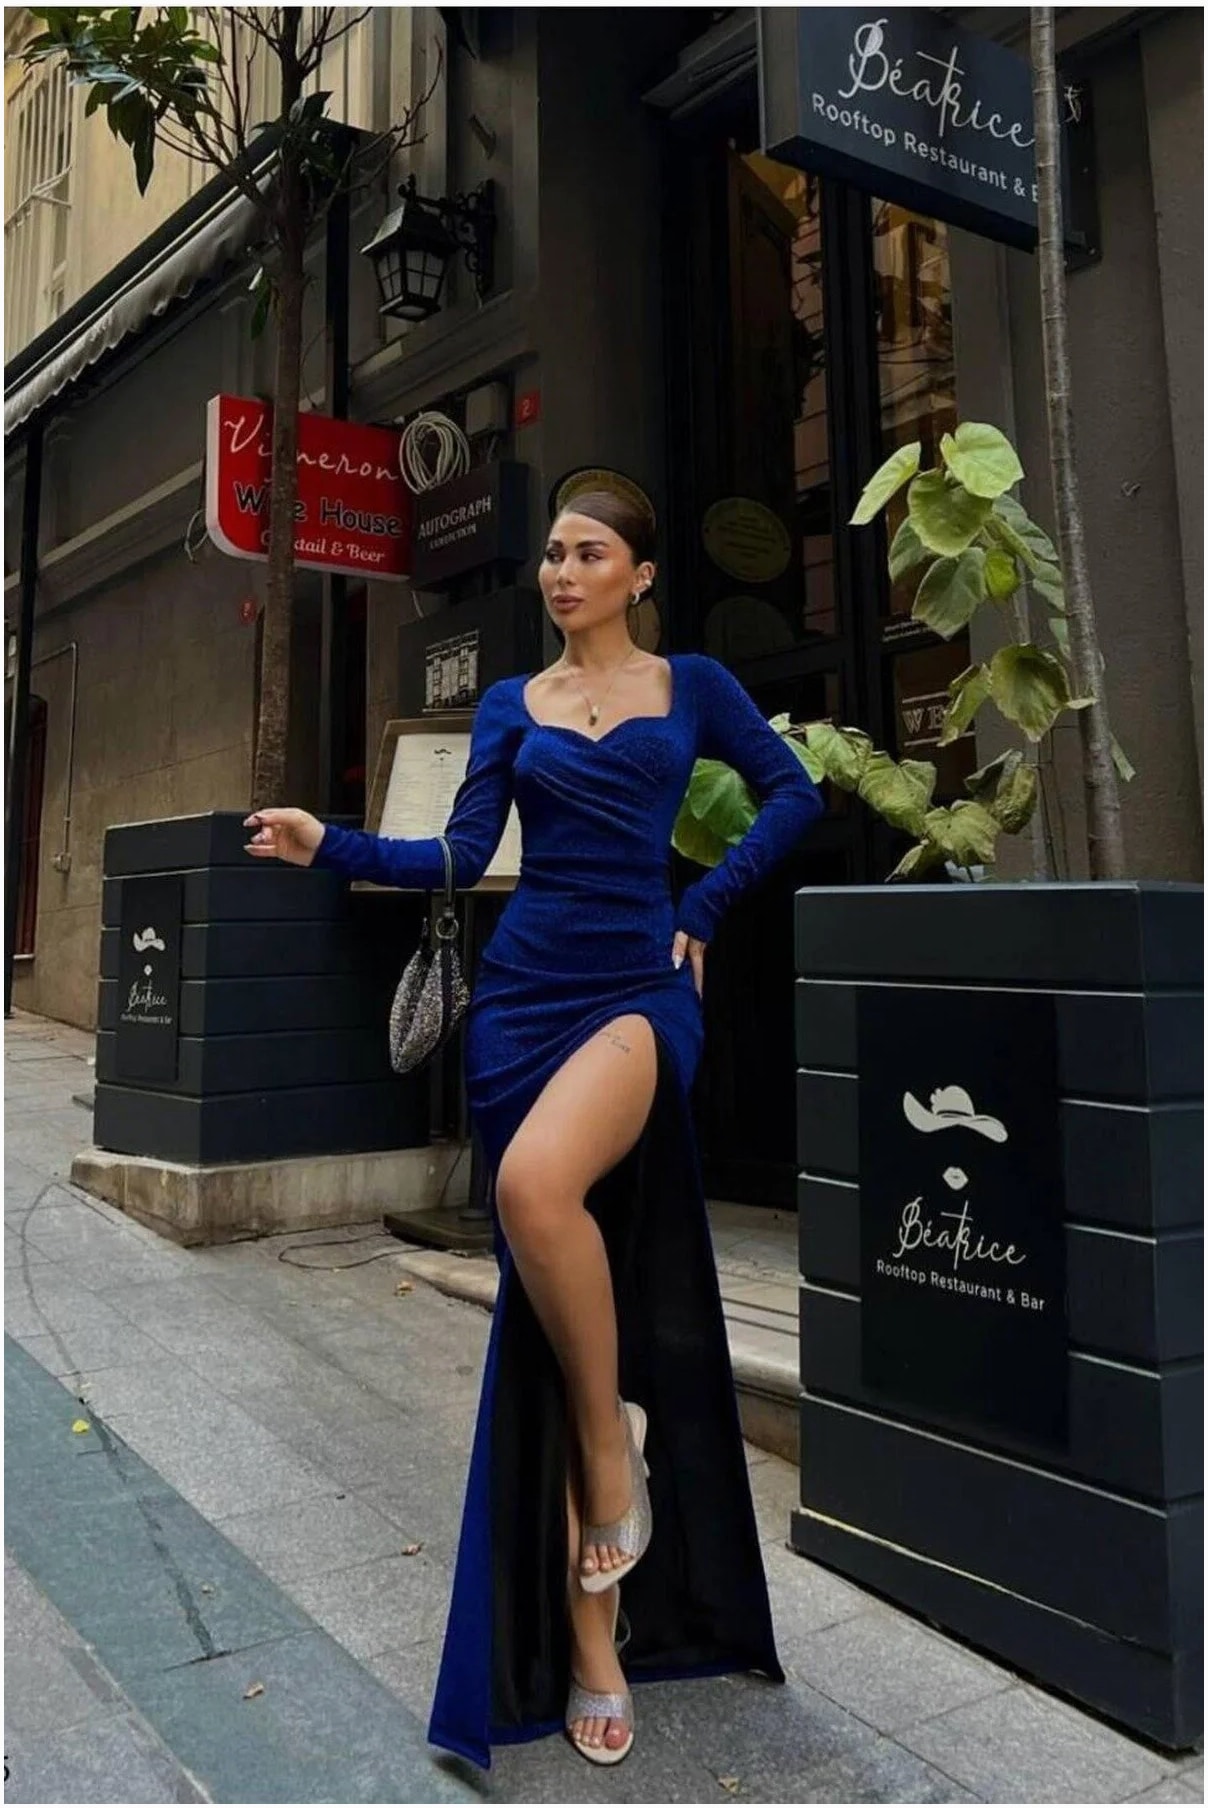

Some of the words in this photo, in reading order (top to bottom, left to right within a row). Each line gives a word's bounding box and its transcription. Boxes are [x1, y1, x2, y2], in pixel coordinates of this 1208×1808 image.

[838, 18, 1036, 148] Béatrice
[812, 93, 896, 146] Rooftop
[904, 133, 1007, 190] Restaurant
[1013, 177, 1026, 197] &
[223, 414, 399, 482] Vineron
[235, 482, 308, 524] We
[320, 497, 401, 537] House
[417, 495, 492, 541] AUTOGRAPH
[331, 540, 345, 557] &
[346, 541, 385, 563] Beer
[892, 1196, 1026, 1271] Béatrice
[876, 1259, 926, 1284] Rooftop
[930, 1271, 1001, 1301] Restaurant
[1006, 1289, 1016, 1304] &
[1020, 1292, 1046, 1311] Bar
